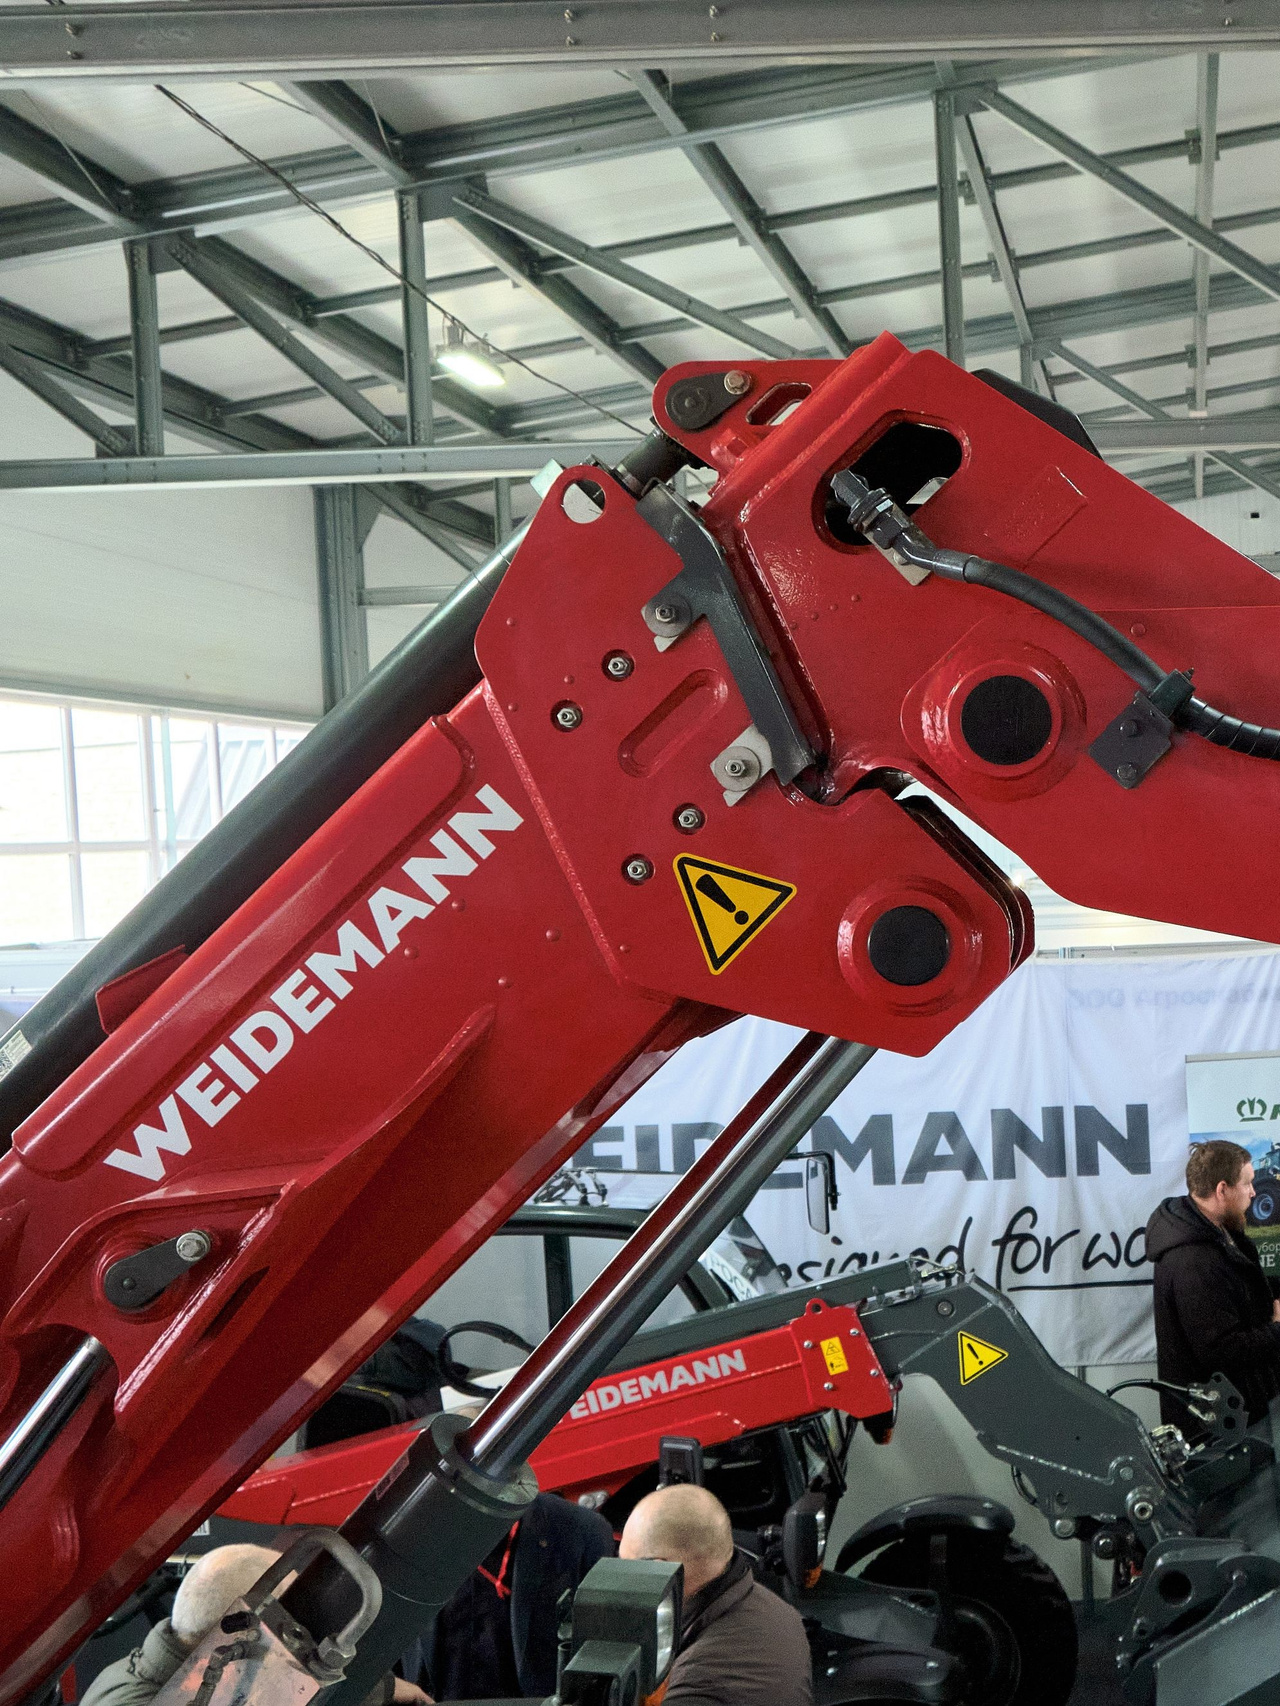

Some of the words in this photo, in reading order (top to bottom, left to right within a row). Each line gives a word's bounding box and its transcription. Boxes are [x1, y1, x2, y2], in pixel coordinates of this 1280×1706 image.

[103, 783, 524, 1183] WEIDEMANN
[572, 1104, 1151, 1190] EIMANN
[992, 1206, 1080, 1291] for
[1082, 1226, 1147, 1272] wo
[568, 1348, 747, 1420] EIDEMANN
